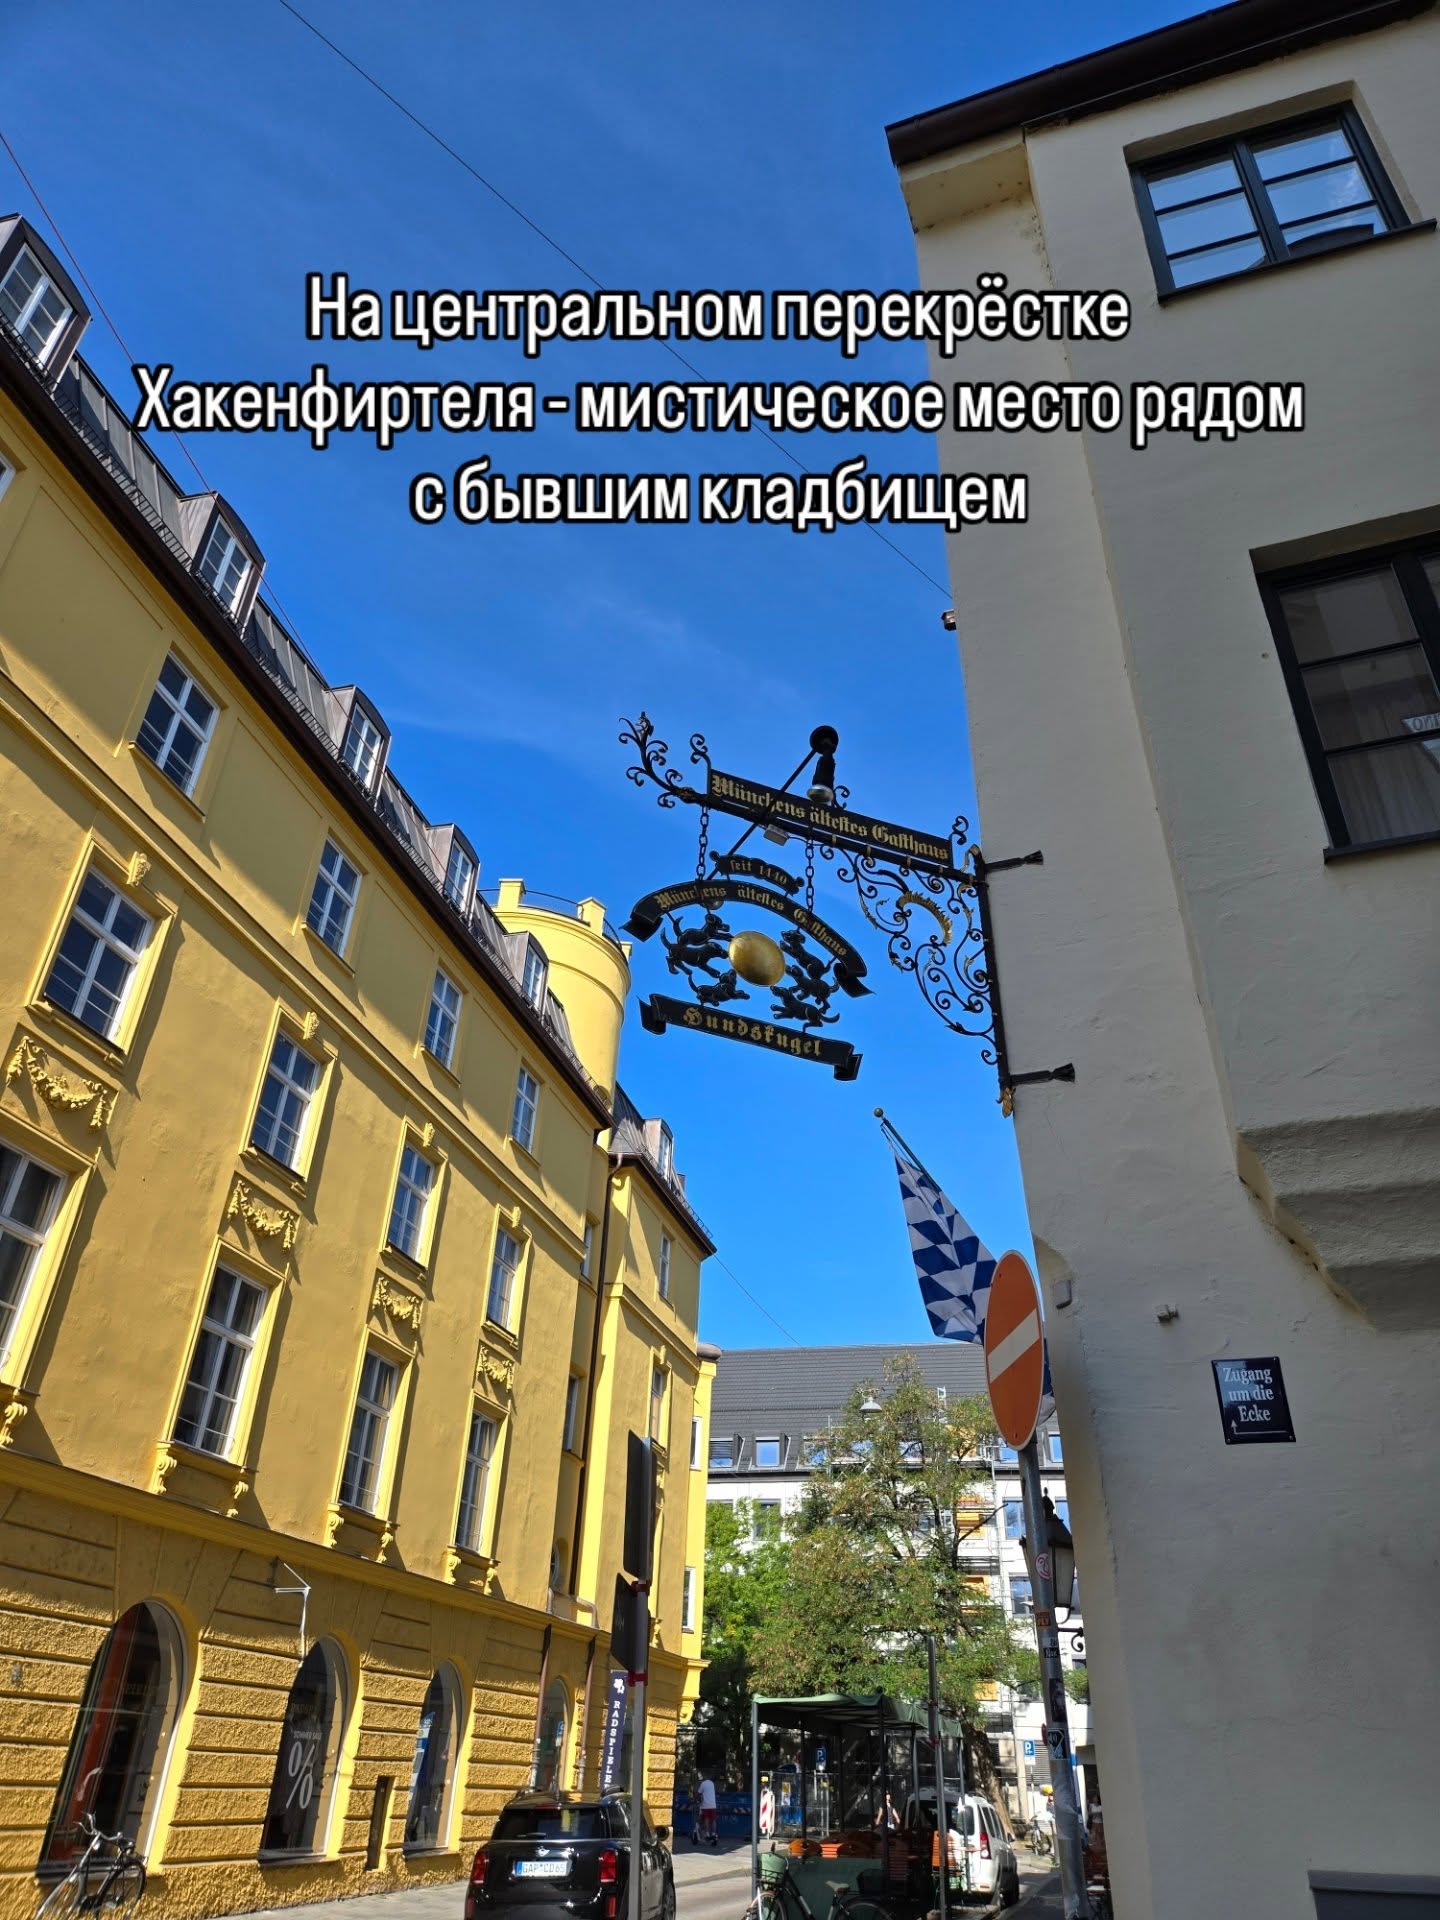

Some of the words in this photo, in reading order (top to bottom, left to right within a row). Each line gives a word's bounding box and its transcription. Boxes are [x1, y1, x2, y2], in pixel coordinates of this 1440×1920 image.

[793, 908, 847, 956] Gsthaus
[683, 1006, 821, 1057] Hundskugel
[1222, 1367, 1273, 1385] Zugang
[1228, 1390, 1251, 1402] um
[1253, 1384, 1275, 1401] die
[1238, 1404, 1272, 1422] Ecke
